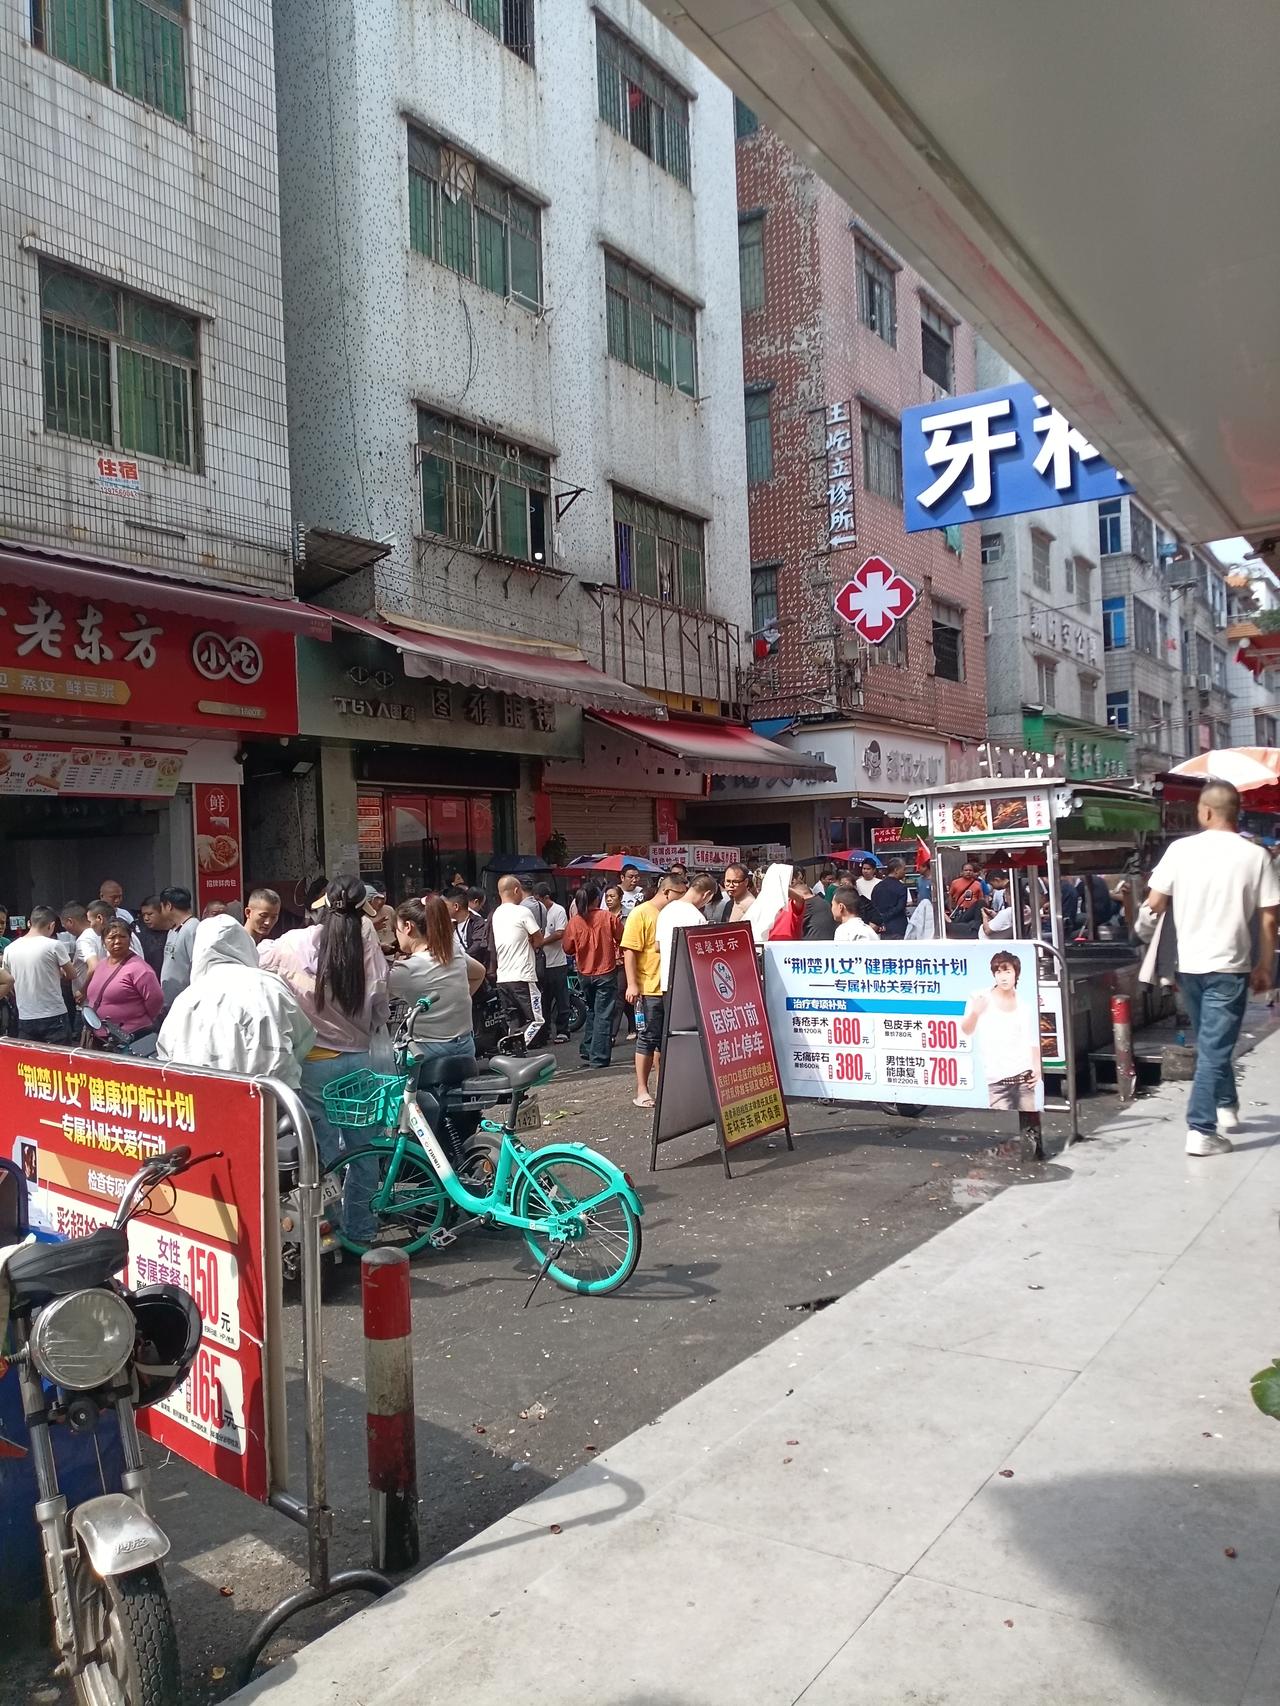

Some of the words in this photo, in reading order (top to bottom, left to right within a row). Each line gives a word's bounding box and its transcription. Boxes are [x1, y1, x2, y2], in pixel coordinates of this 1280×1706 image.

[97, 457, 138, 480] 住宿
[826, 402, 856, 532] 王屹立诊所
[0, 598, 163, 669] 老东方
[200, 641, 257, 676] 小吃
[210, 794, 225, 812] 鲜
[694, 938, 739, 955] 温馨提示
[792, 999, 847, 1010] 治疗专项补贴
[709, 1002, 760, 1034] 医院门前
[792, 1016, 829, 1027] 痔疮手术
[884, 1019, 923, 1030] 包皮手术
[717, 1031, 766, 1065] 禁止停车
[793, 1051, 830, 1062] 无痛碎石
[886, 1056, 925, 1067] 男性性功
[886, 1067, 916, 1078] 能康复
[57, 1206, 111, 1239] 彩超检
[157, 1235, 181, 1266] 女性
[136, 1254, 181, 1287] 专属套餐
